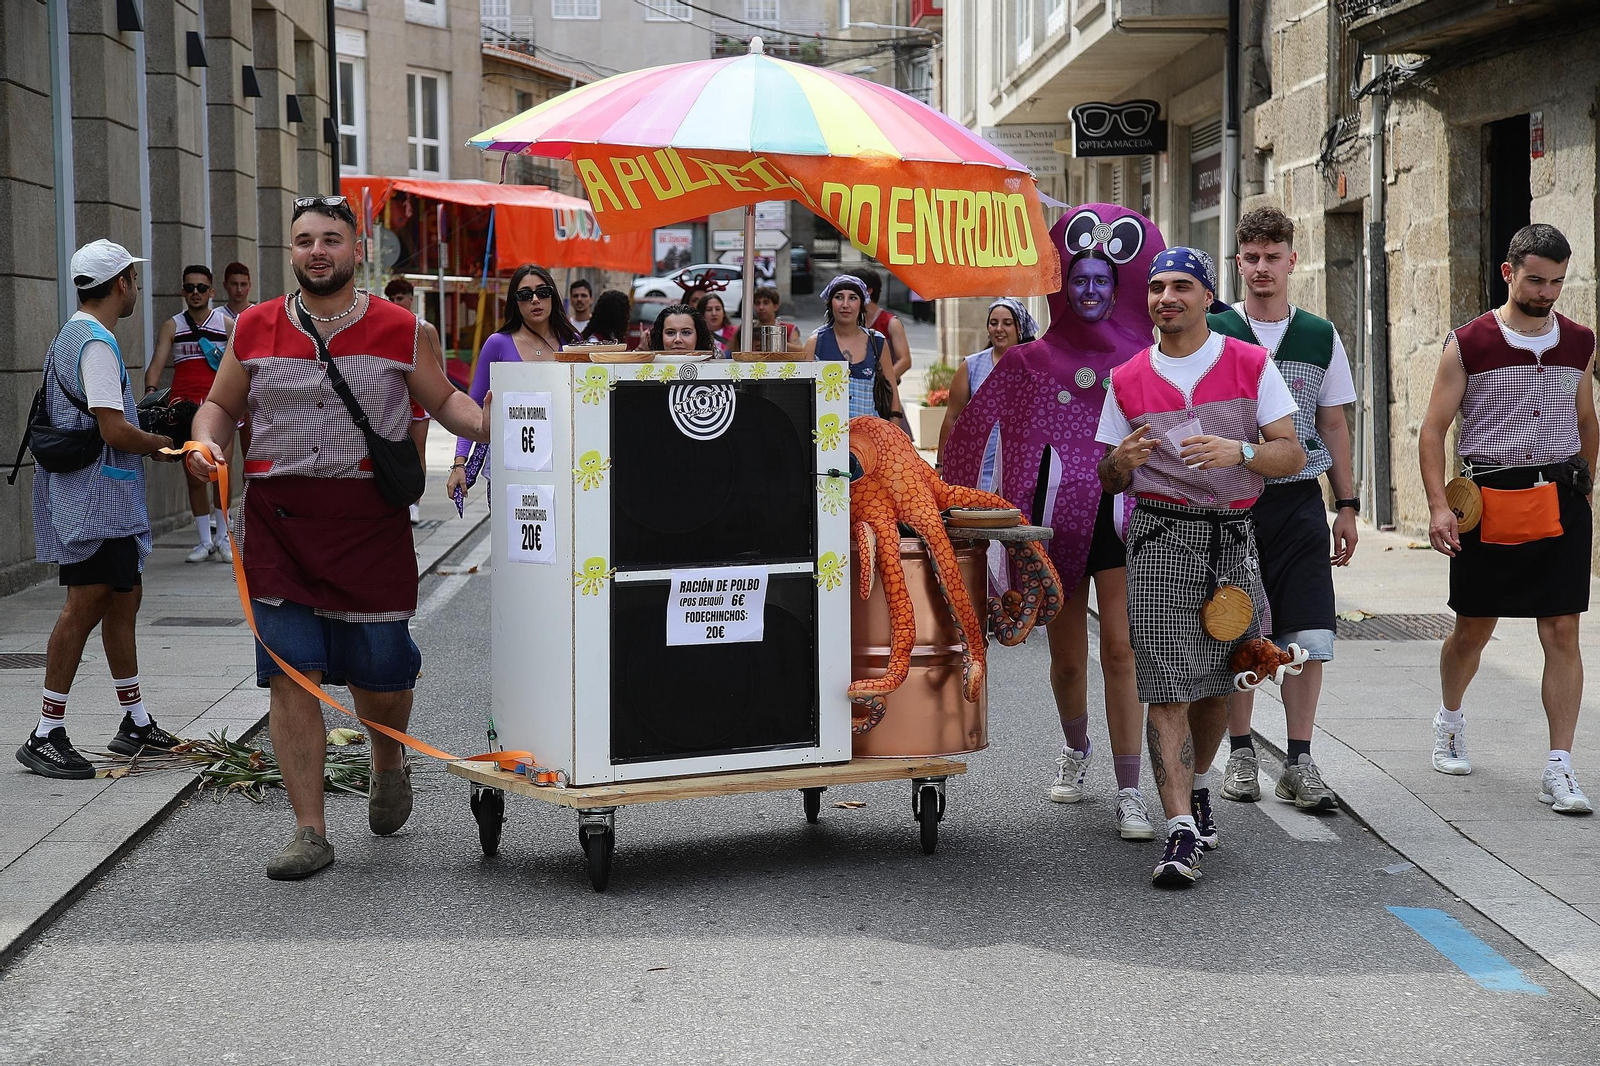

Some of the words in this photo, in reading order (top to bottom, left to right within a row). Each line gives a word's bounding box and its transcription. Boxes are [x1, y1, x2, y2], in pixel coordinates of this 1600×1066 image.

[1025, 129, 1057, 138] Dental
[1079, 140, 1113, 149] OPTICA
[1114, 139, 1153, 148] MACEDA
[577, 158, 624, 213] A
[821, 181, 880, 258] DO
[527, 406, 547, 420] NORMAL
[522, 426, 535, 453] 6€
[522, 524, 542, 551] 20€
[679, 577, 714, 593] RACIÓN
[716, 580, 728, 592] DE
[730, 578, 760, 591] POLBO
[679, 597, 696, 607] (POS
[731, 594, 745, 606] 6€
[685, 610, 748, 623] FODECHINCHOS:
[706, 626, 725, 639] 20€
